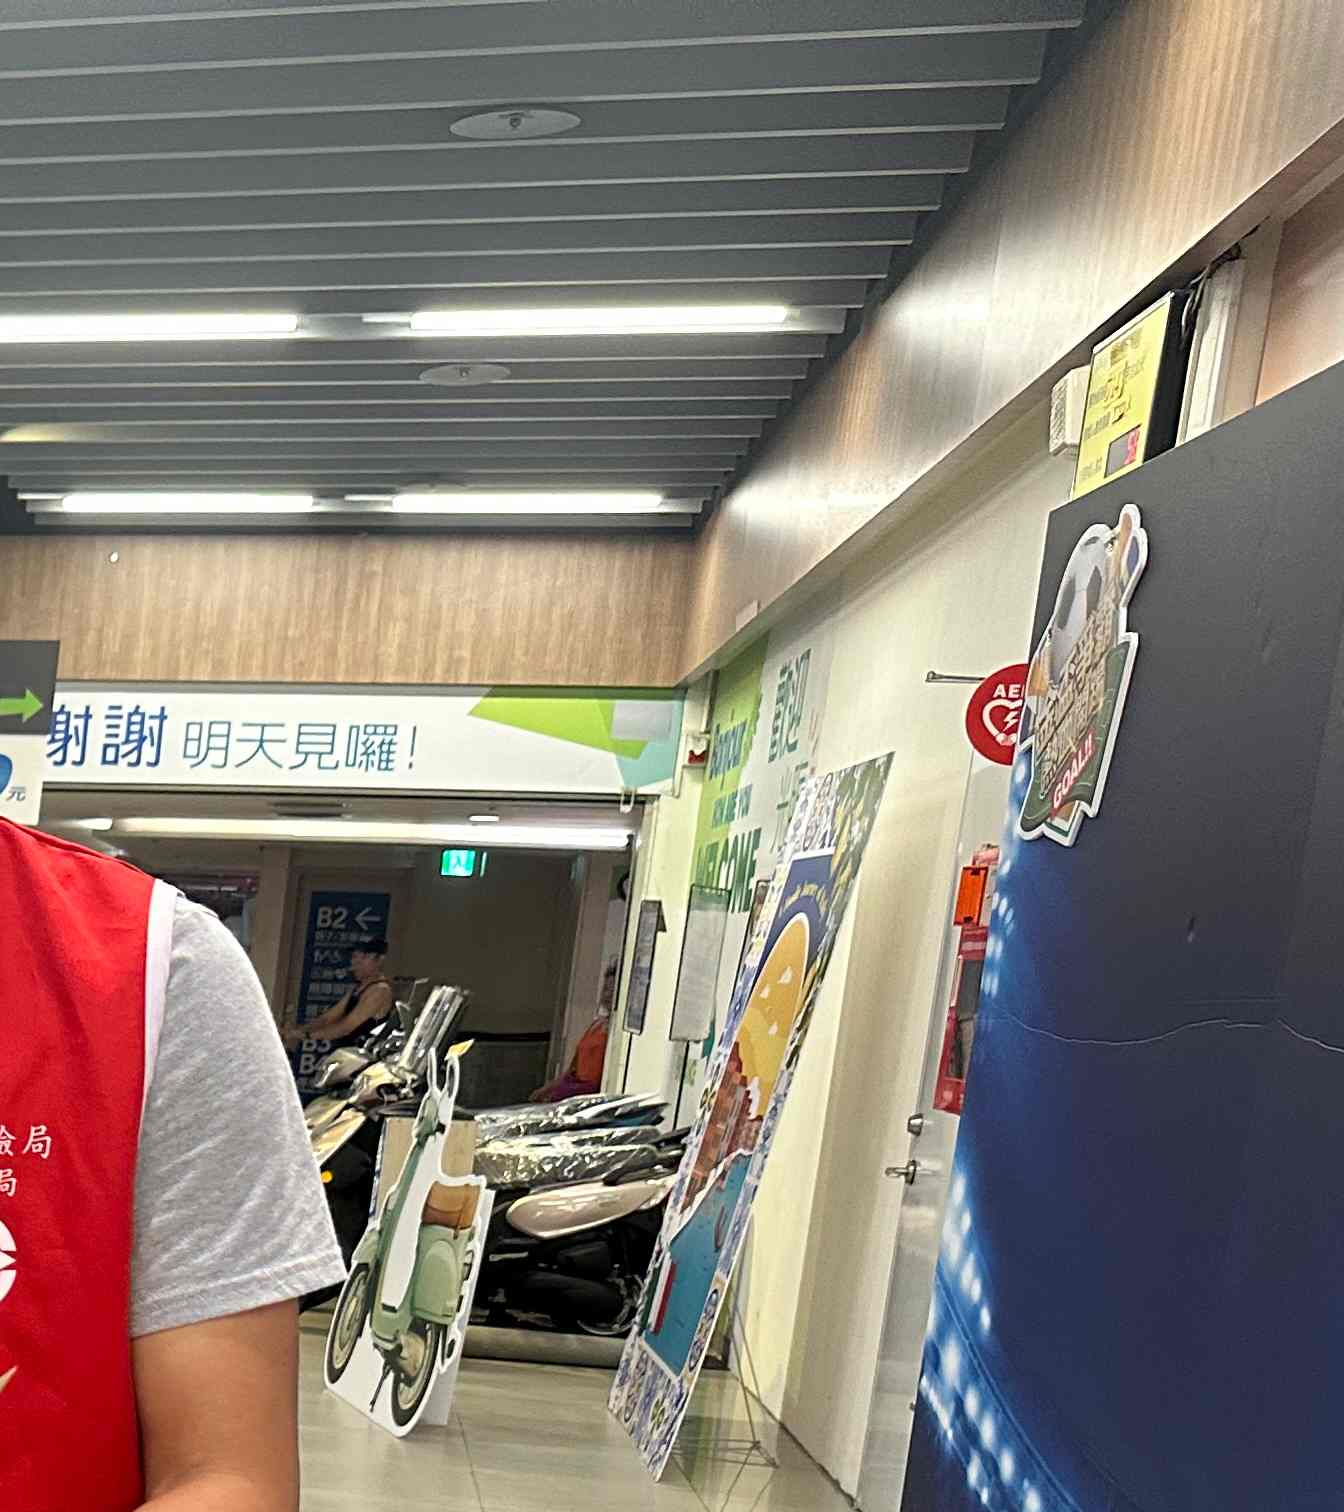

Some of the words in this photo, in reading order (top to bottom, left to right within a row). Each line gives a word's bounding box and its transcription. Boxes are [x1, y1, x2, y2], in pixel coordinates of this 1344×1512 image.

[993, 684, 1025, 698] AE
[6, 787, 26, 801] 元
[317, 906, 349, 929] B2
